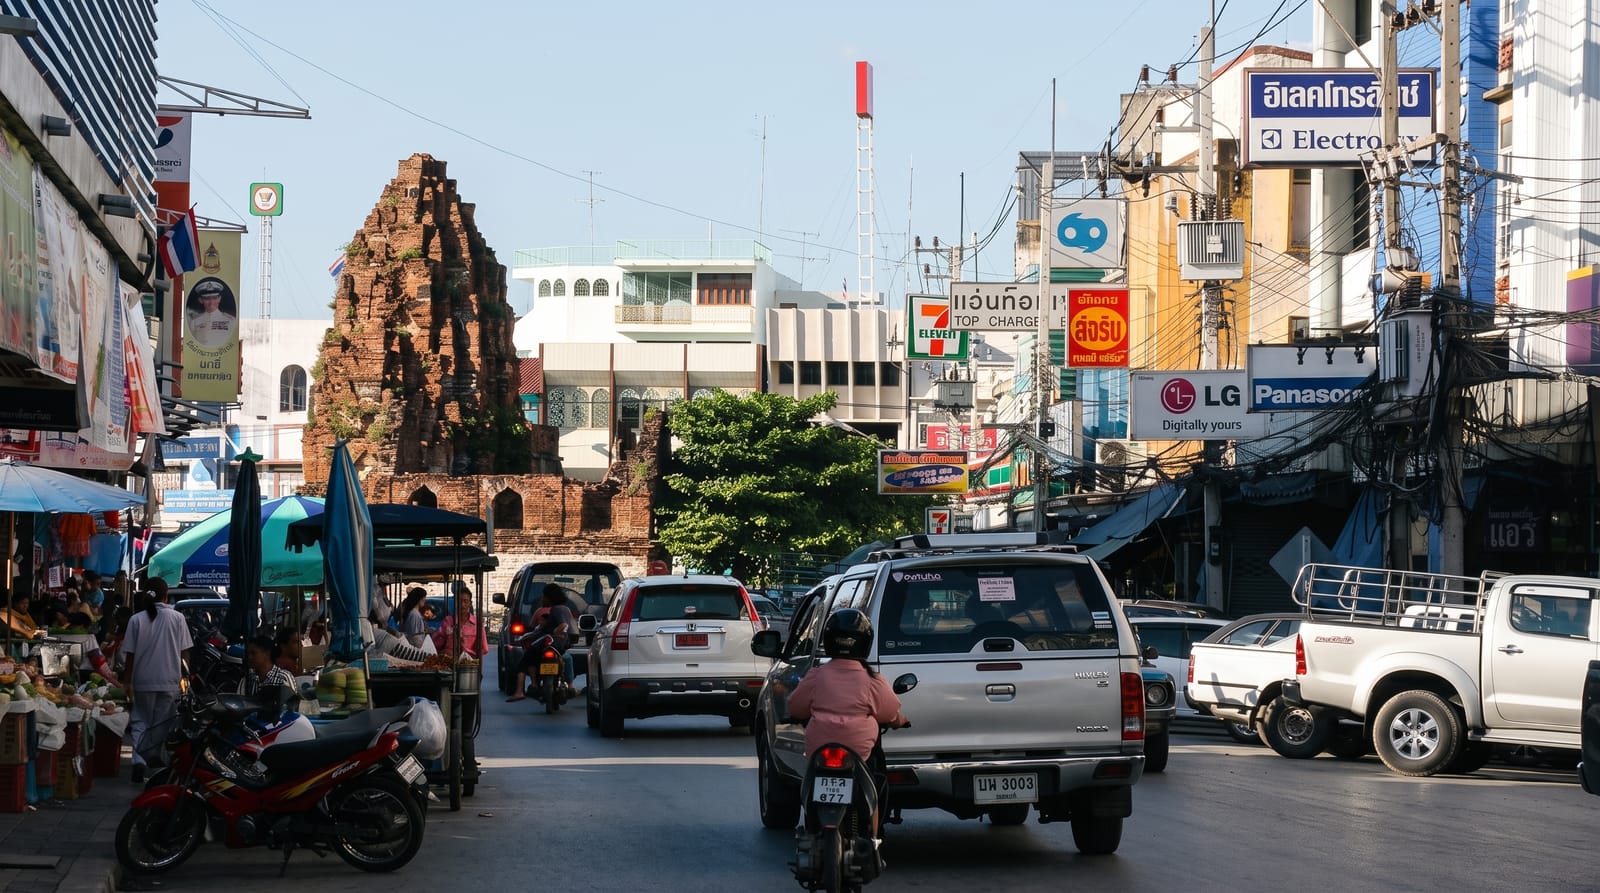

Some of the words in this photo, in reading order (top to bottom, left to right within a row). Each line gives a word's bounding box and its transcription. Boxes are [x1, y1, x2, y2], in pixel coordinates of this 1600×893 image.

[954, 315, 980, 327] TOP
[1204, 385, 1241, 407] LG
[1162, 418, 1208, 433] Digitally
[1210, 421, 1242, 433] yours
[1001, 777, 1034, 791] 3003
